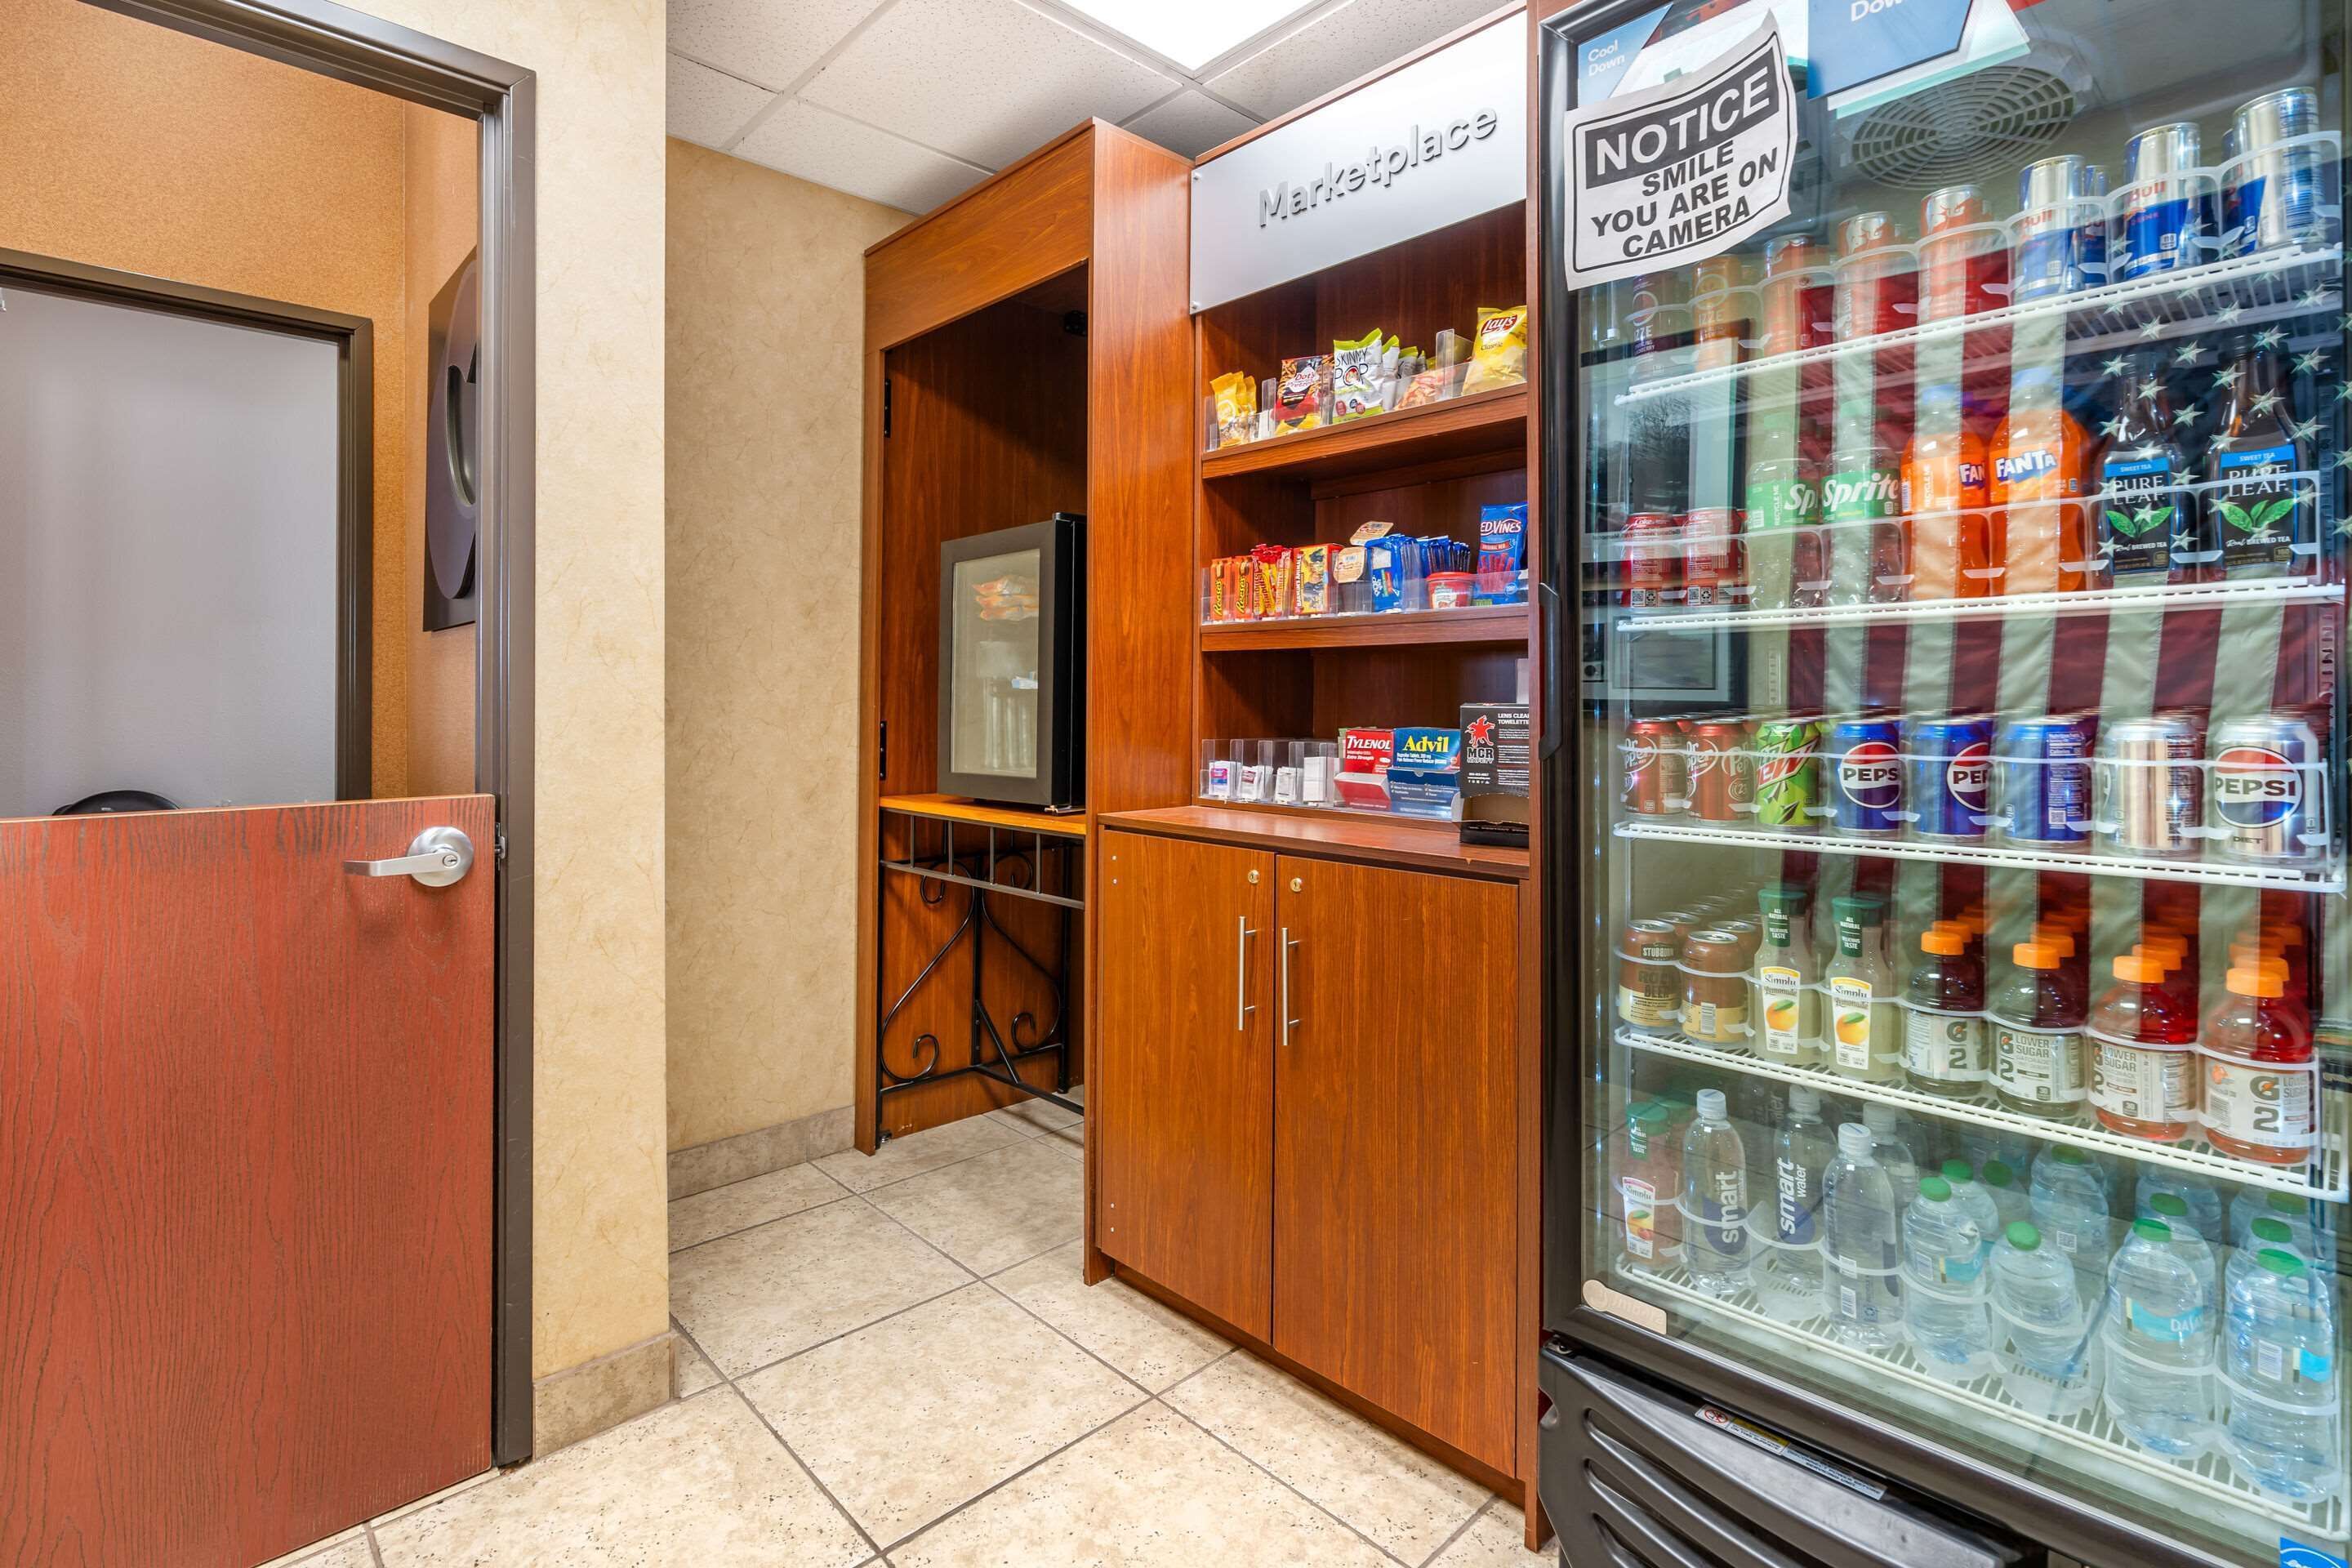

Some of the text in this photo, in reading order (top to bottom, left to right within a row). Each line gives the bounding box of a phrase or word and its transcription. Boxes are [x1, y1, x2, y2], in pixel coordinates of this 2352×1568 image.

[1851, 0, 1902, 21] Dow
[1588, 39, 1618, 62] Cool
[1588, 54, 1625, 76] Down
[1597, 66, 1770, 176] NOTICE
[1258, 107, 1497, 228] Marketplace
[1642, 140, 1733, 196] SMILE
[1591, 147, 1777, 237] YOU ARE ON
[1623, 196, 1750, 257] CAMERA
[1481, 316, 1517, 334] Lay's
[1337, 348, 1368, 367] SKINNY
[1295, 372, 1314, 381] Dot's
[1335, 363, 1369, 386] POP
[1959, 462, 1985, 483] FAN
[1995, 450, 2057, 479] FANTA
[2229, 465, 2287, 479] PURE
[1823, 472, 1898, 512] Sprite
[2113, 475, 2163, 490] PURE
[1772, 485, 1780, 526] RECYCLE ME
[1784, 483, 1817, 515] Sp
[1481, 519, 1521, 533] ED VINES
[1214, 579, 1223, 616] Reese's
[1236, 576, 1246, 613] Reese's
[1347, 736, 1391, 751] TYLENOL
[1402, 735, 1450, 752] Advil
[1467, 747, 1494, 759] MCR
[1843, 768, 1899, 782] PEPS
[2215, 776, 2296, 796] PEPSI
[2233, 835, 2263, 844] DIET
[1840, 921, 1860, 929] NATURAL
[1771, 932, 1786, 940] TASTE
[1844, 941, 1858, 950] TASTE
[2016, 1034, 2050, 1048] LOWER
[2016, 1045, 2050, 1058] SUGAR
[1949, 1048, 1967, 1069] 2
[2104, 1046, 2137, 1062] LOWER
[2104, 1056, 2137, 1072] SUGAR
[2253, 1106, 2279, 1133] 2
[1797, 1164, 1807, 1198] water
[1777, 1156, 1797, 1235] smart
[1716, 1170, 1739, 1244] smart
